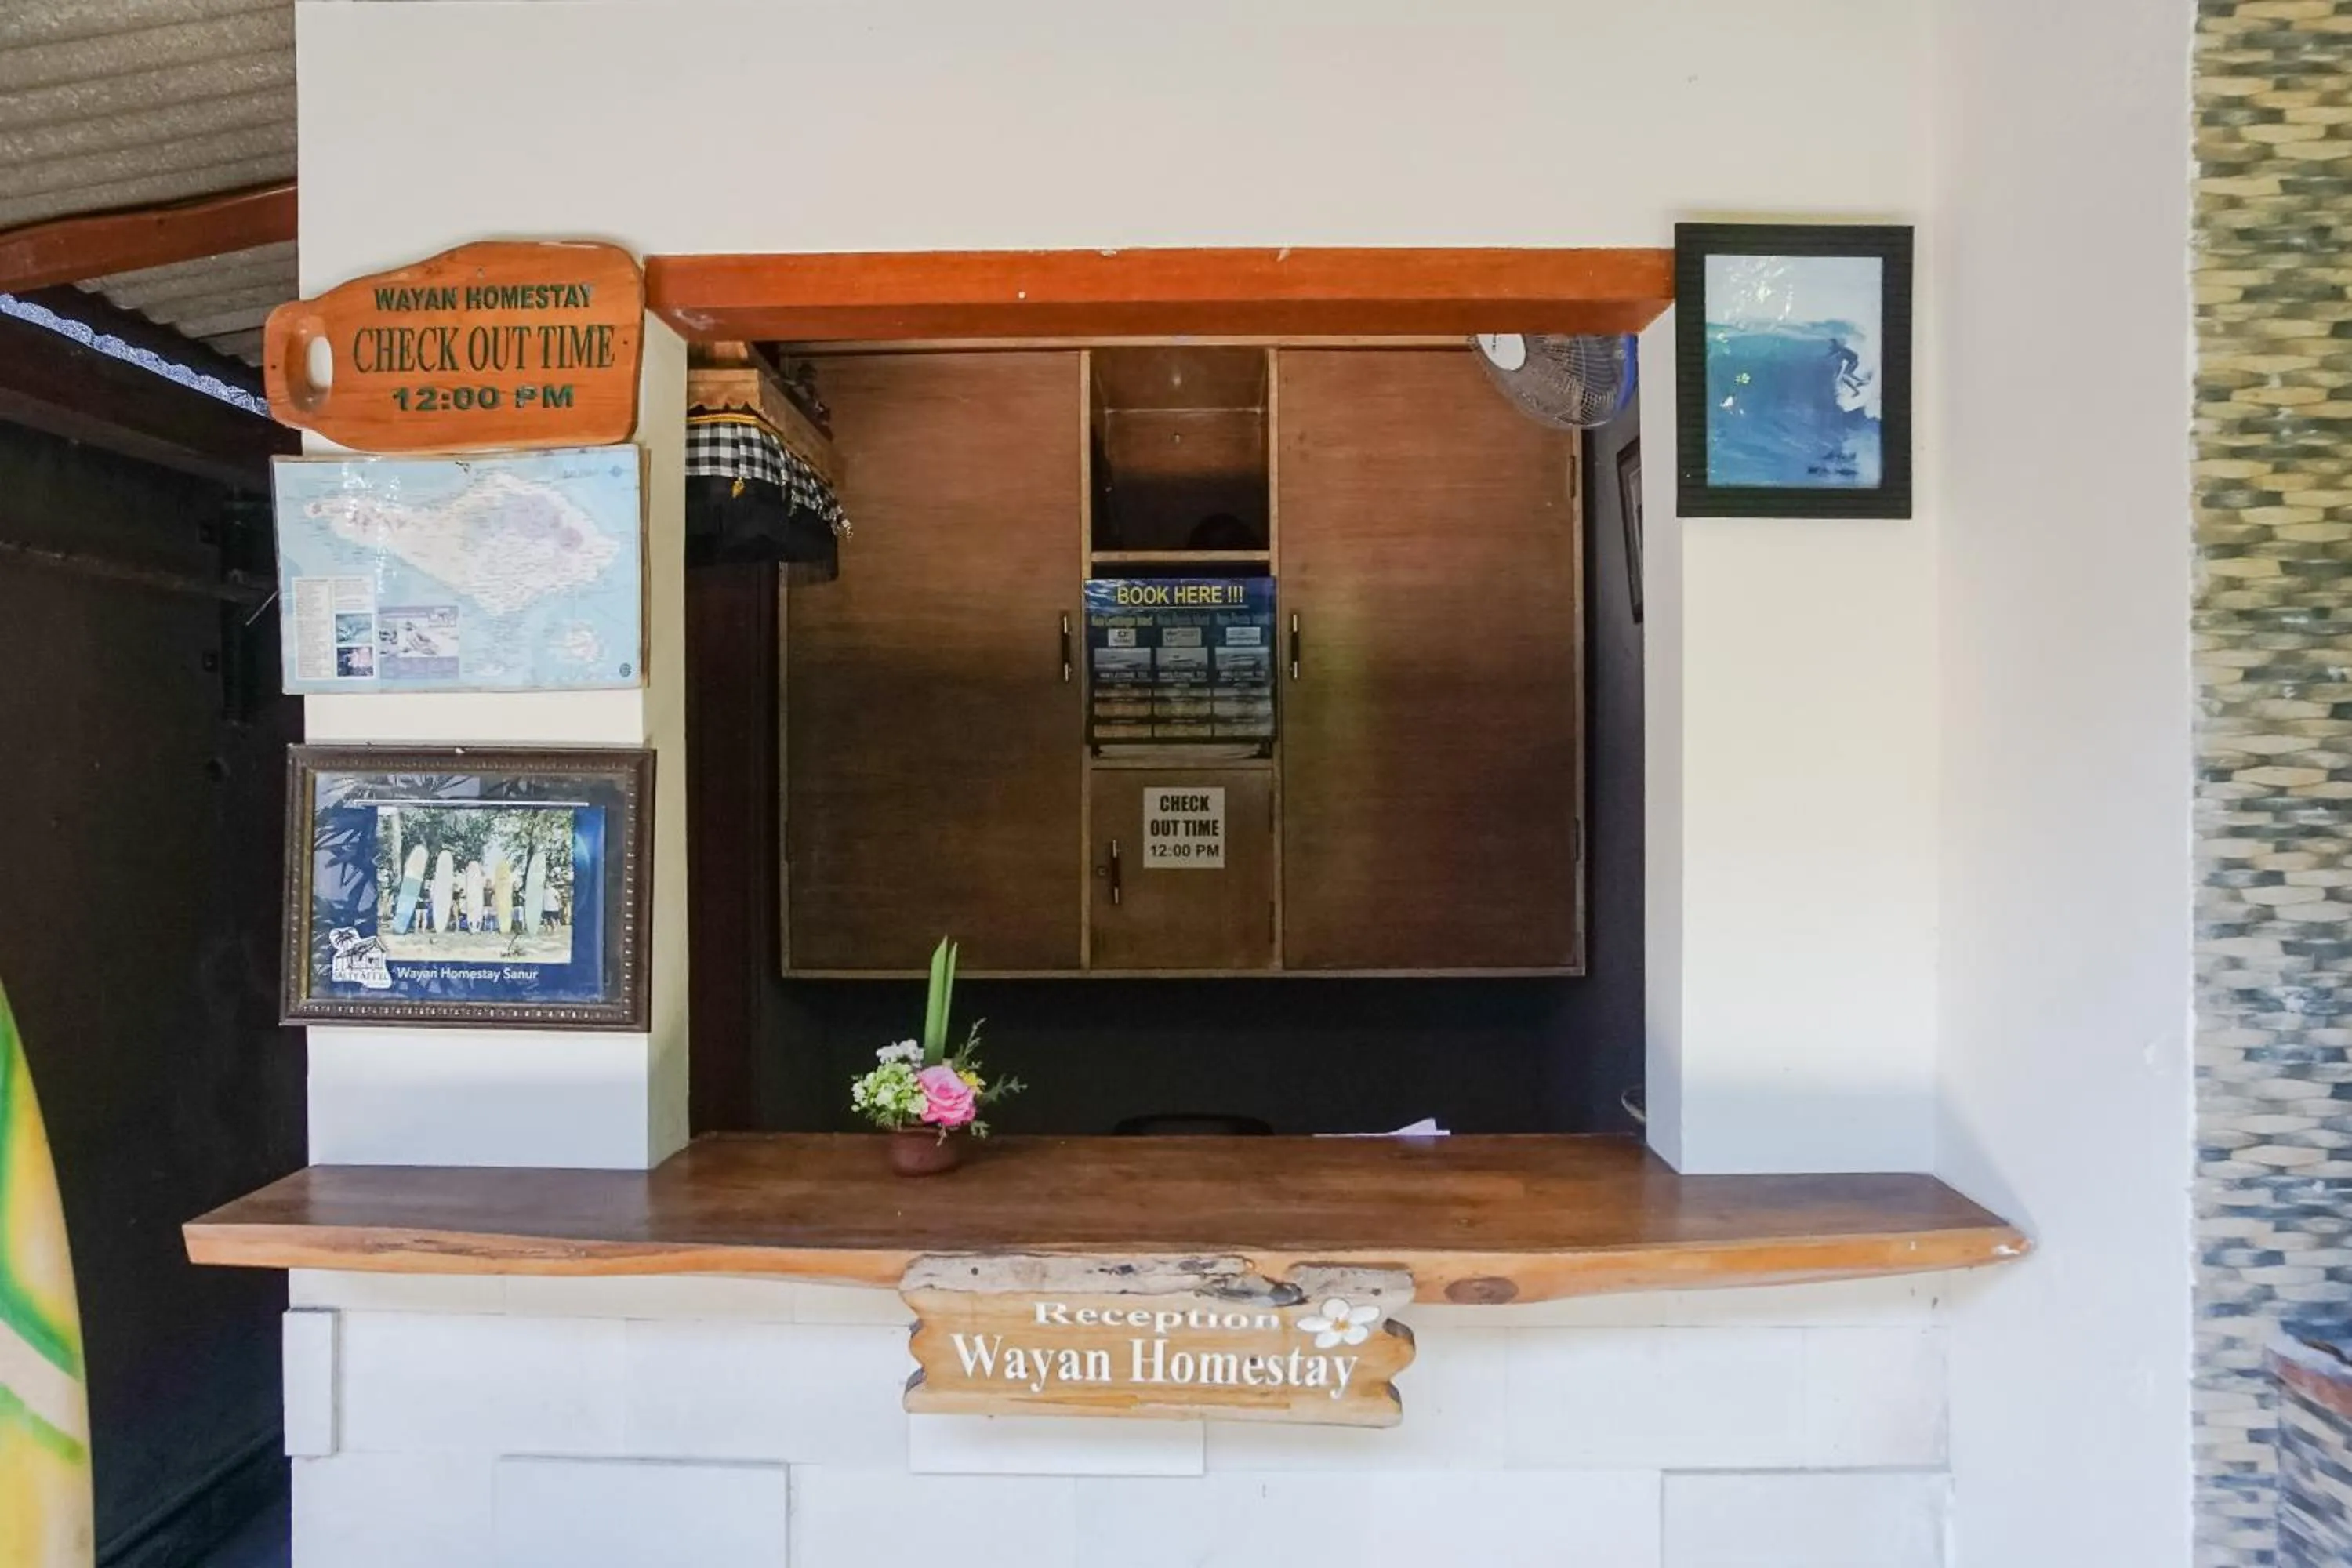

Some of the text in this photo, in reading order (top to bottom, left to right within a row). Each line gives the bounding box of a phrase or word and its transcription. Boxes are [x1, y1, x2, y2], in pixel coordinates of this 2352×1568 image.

[374, 284, 593, 312] WAYAN HOMESTAY
[352, 324, 615, 373] CHECK OUT TIME
[392, 383, 575, 412] 12:00 PM
[1116, 586, 1170, 604] BOOK
[1174, 586, 1222, 604] HERE
[1160, 795, 1210, 812] CHECK
[1150, 819, 1220, 837] OUT TIME
[1150, 844, 1220, 858] 12:00 PM
[397, 967, 438, 982] Wayan
[441, 967, 501, 983] Homestay
[503, 968, 539, 981] Sanur
[1033, 1301, 1283, 1333] Reception
[951, 1334, 1360, 1399] Wayan Homestay
